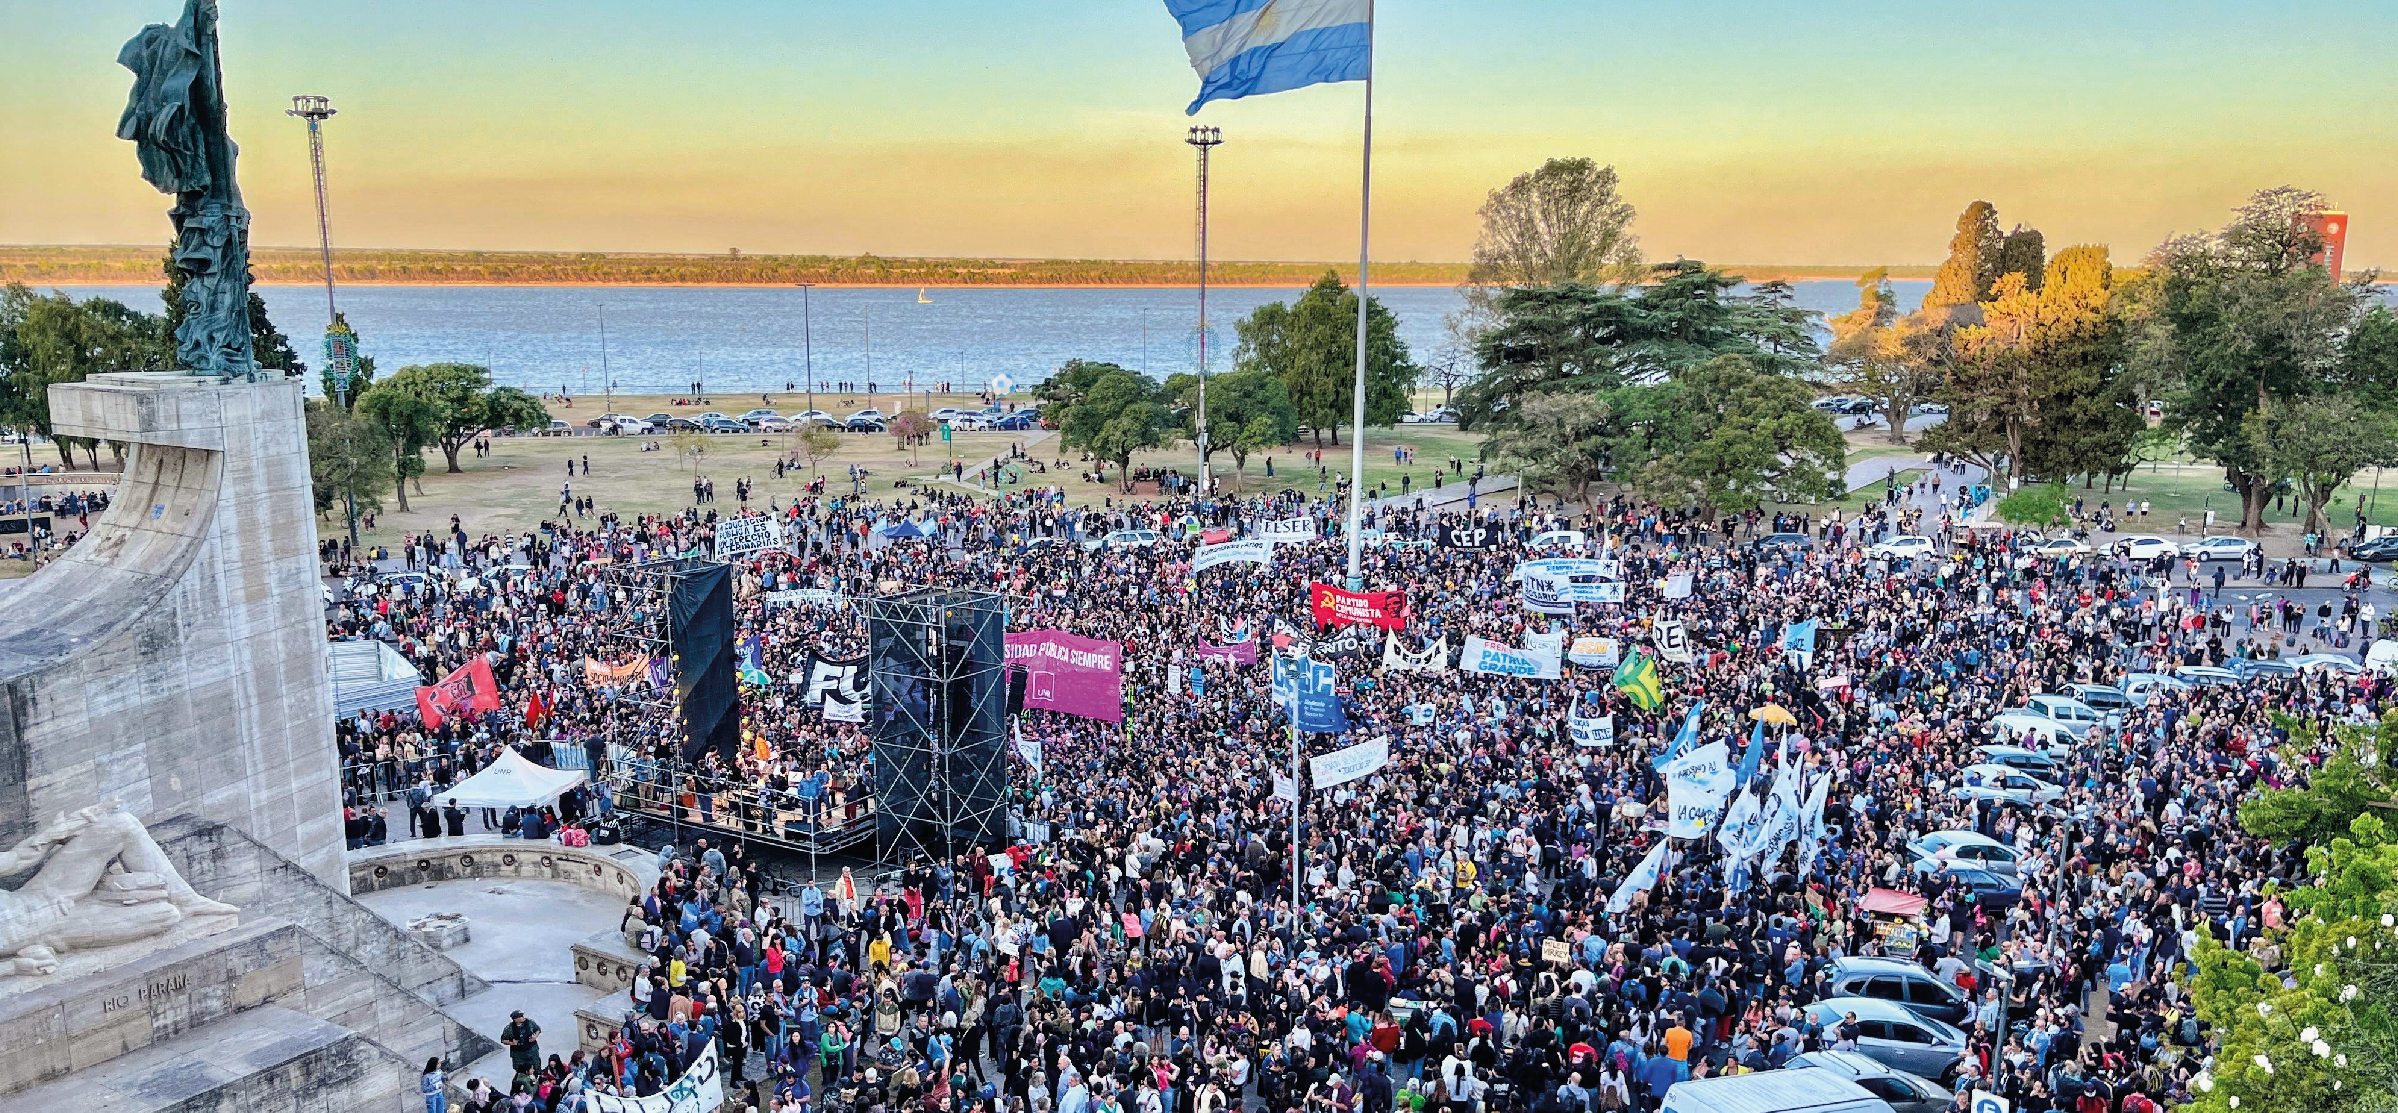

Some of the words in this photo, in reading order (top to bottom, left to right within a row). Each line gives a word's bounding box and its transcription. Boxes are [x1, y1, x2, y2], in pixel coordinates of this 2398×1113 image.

[754, 522, 767, 533] ES
[730, 530, 771, 546] DERECHO
[1451, 528, 1487, 547] CEP
[1335, 595, 1369, 608] PARTIDO
[1335, 603, 1383, 619] COMUNISTA
[1481, 649, 1532, 667] PATRIA
[1478, 660, 1536, 676] GRANDE
[138, 972, 192, 1001] PARANA
